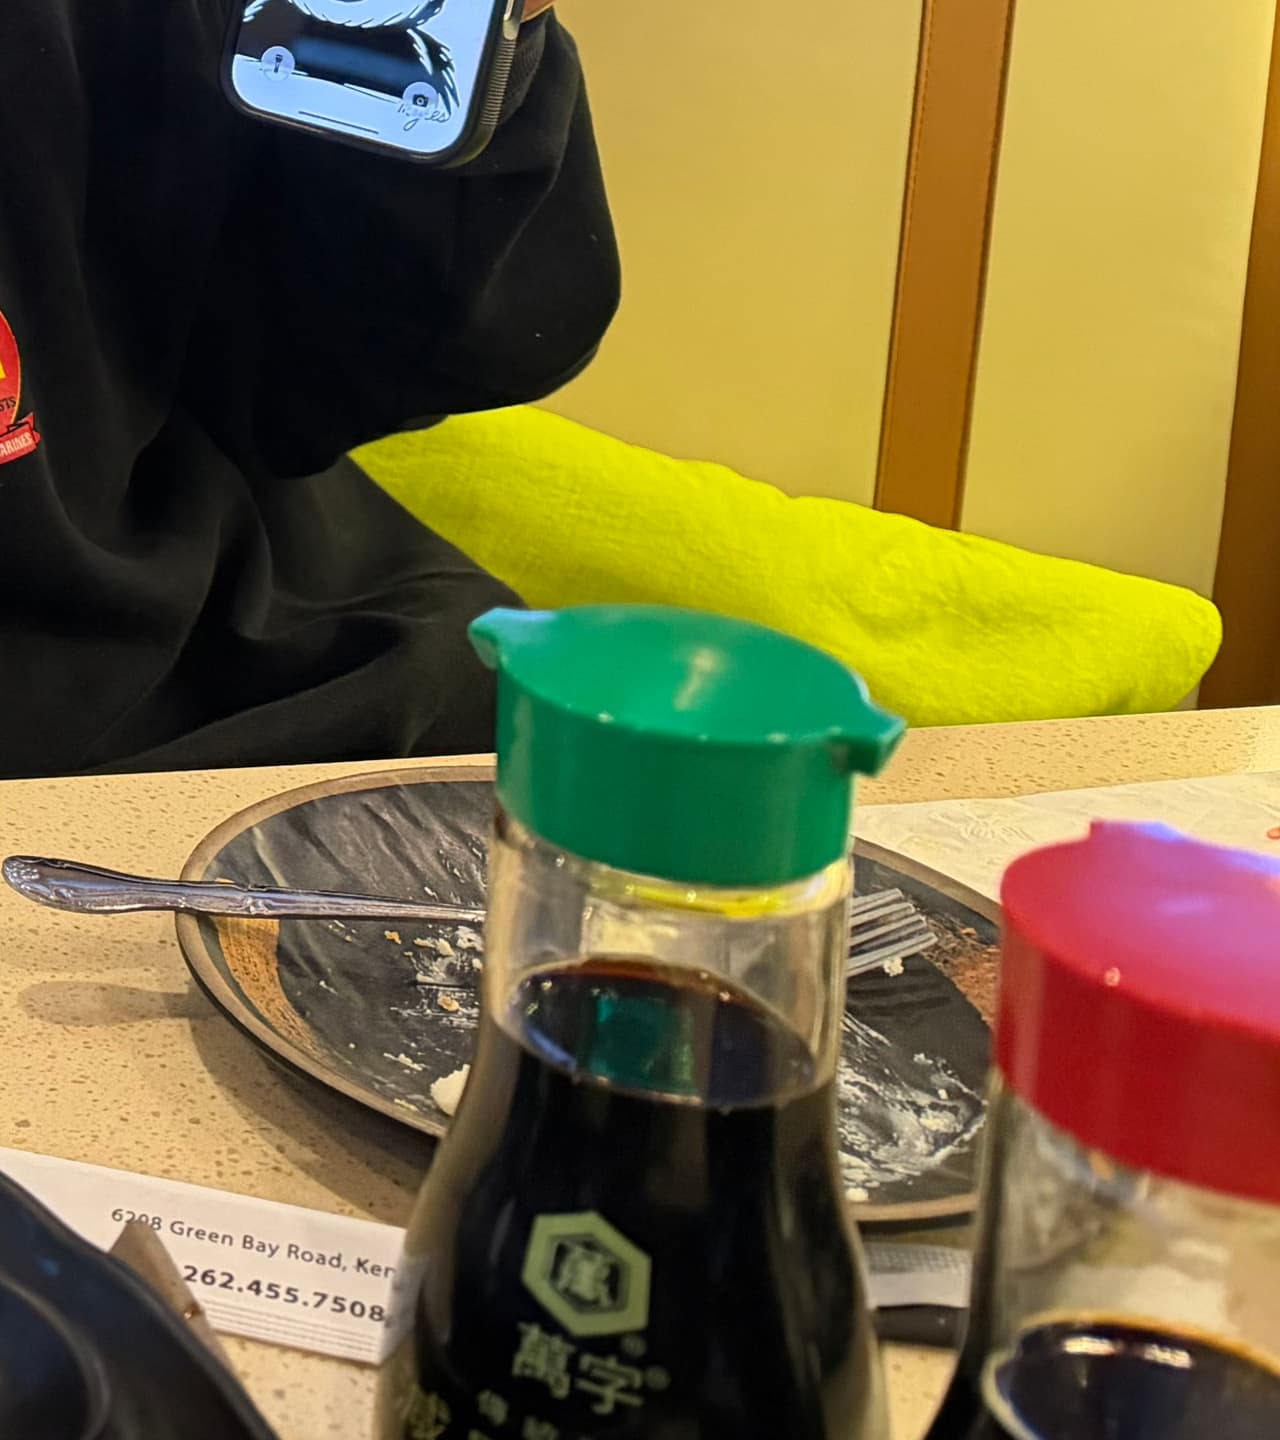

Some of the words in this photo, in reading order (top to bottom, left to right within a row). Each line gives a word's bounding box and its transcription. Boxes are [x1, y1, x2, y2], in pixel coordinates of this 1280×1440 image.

[169, 1220, 234, 1247] Green
[242, 1234, 280, 1258] Bay
[287, 1243, 347, 1272] Road,
[183, 1265, 386, 1322] 262.455.7508
